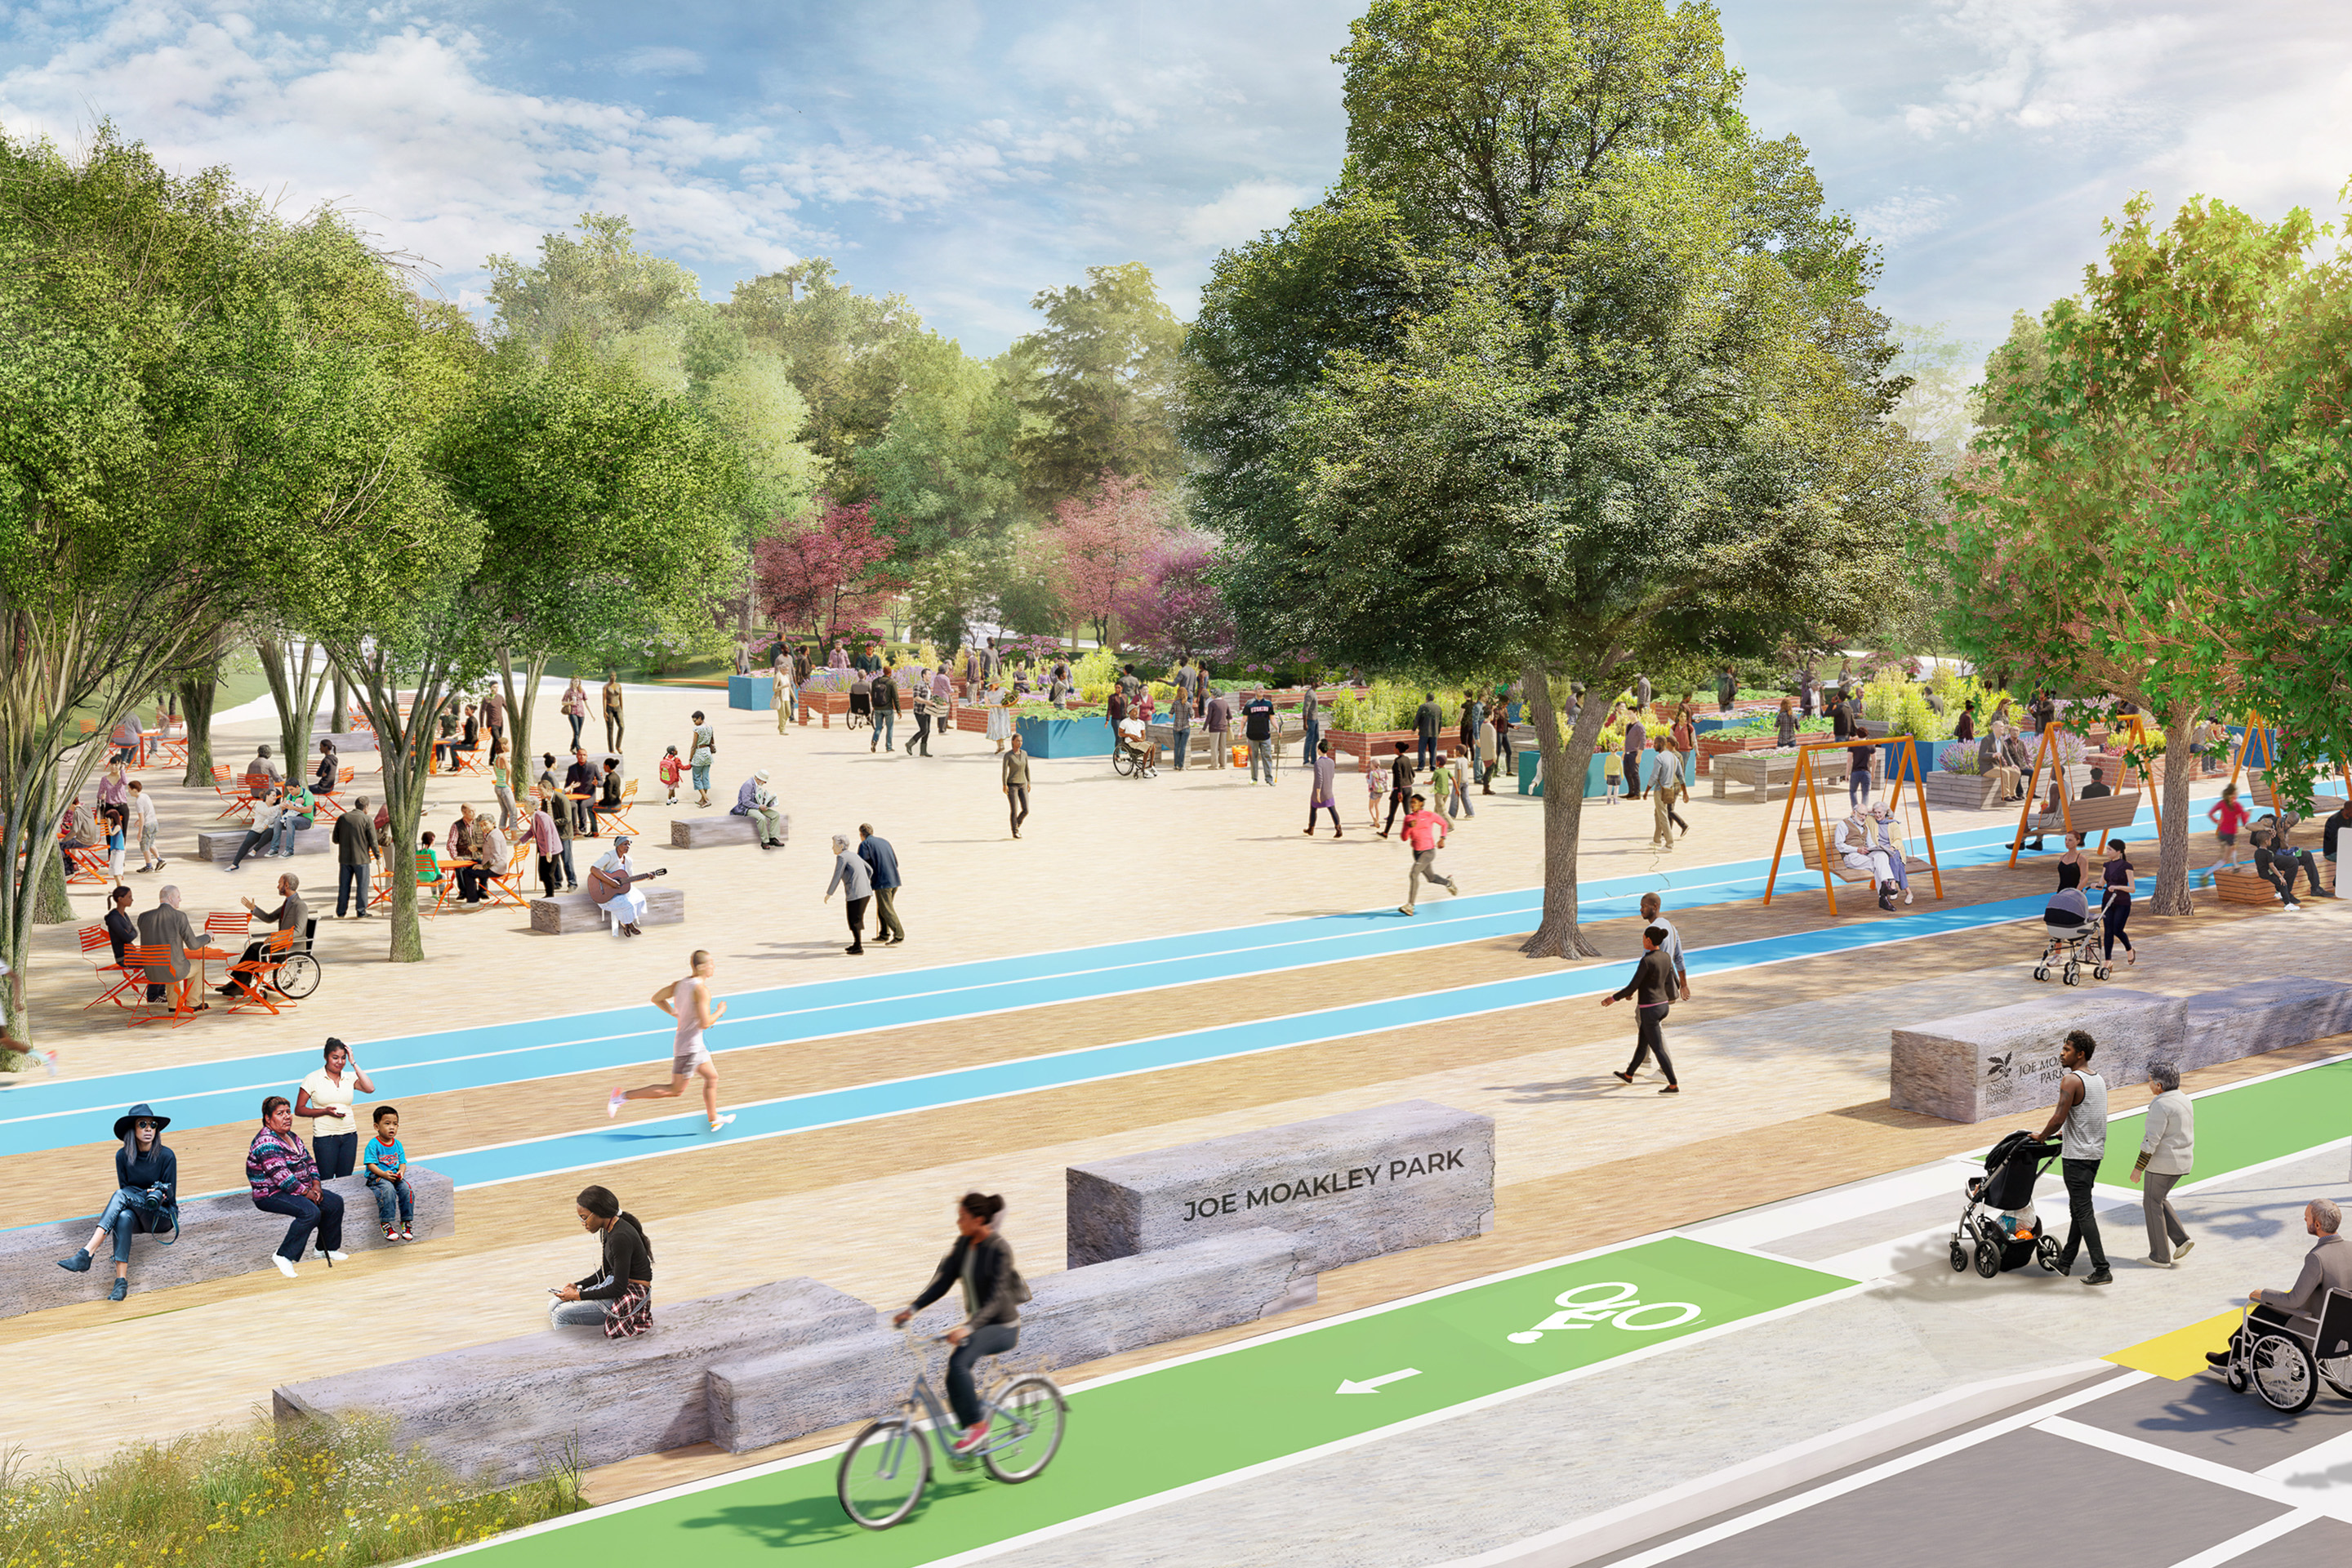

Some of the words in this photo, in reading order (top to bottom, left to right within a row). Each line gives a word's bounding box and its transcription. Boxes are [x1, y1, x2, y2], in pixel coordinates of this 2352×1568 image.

[2018, 1062, 2036, 1078] JOE
[2040, 1067, 2065, 1084] PARK
[1183, 1192, 1237, 1222] JOE
[1245, 1165, 1381, 1209] MOAKLEY
[1389, 1147, 1465, 1181] PARK
